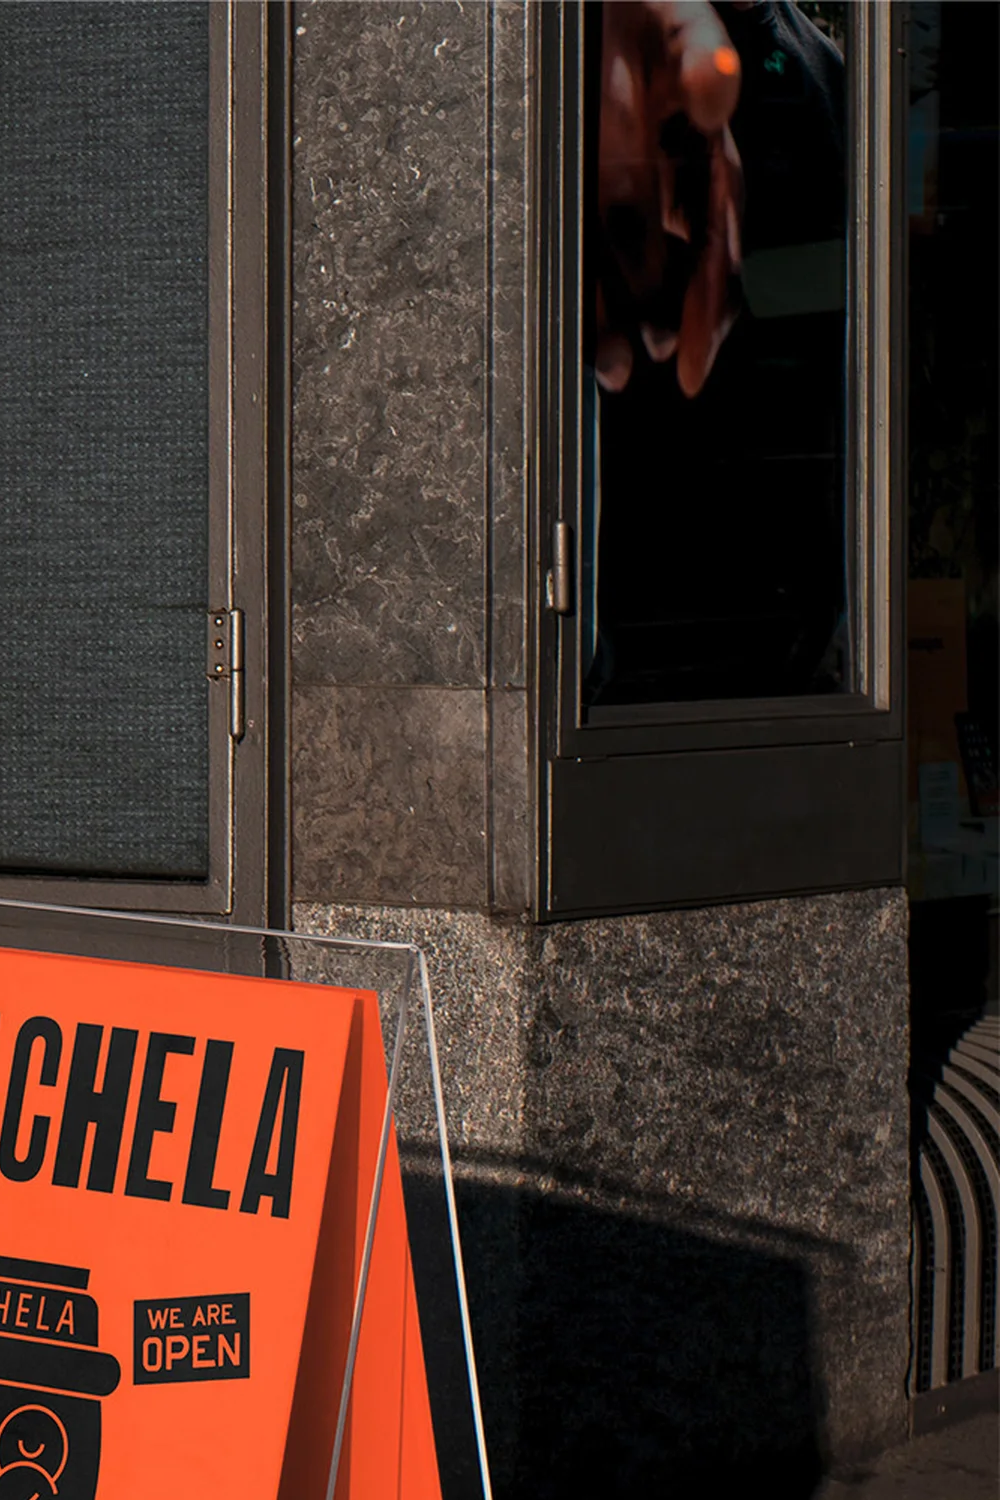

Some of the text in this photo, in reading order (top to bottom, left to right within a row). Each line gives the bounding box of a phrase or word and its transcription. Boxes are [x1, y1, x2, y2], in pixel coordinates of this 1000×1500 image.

[147, 1303, 237, 1330] WE ARE
[142, 1332, 242, 1373] OPEN
